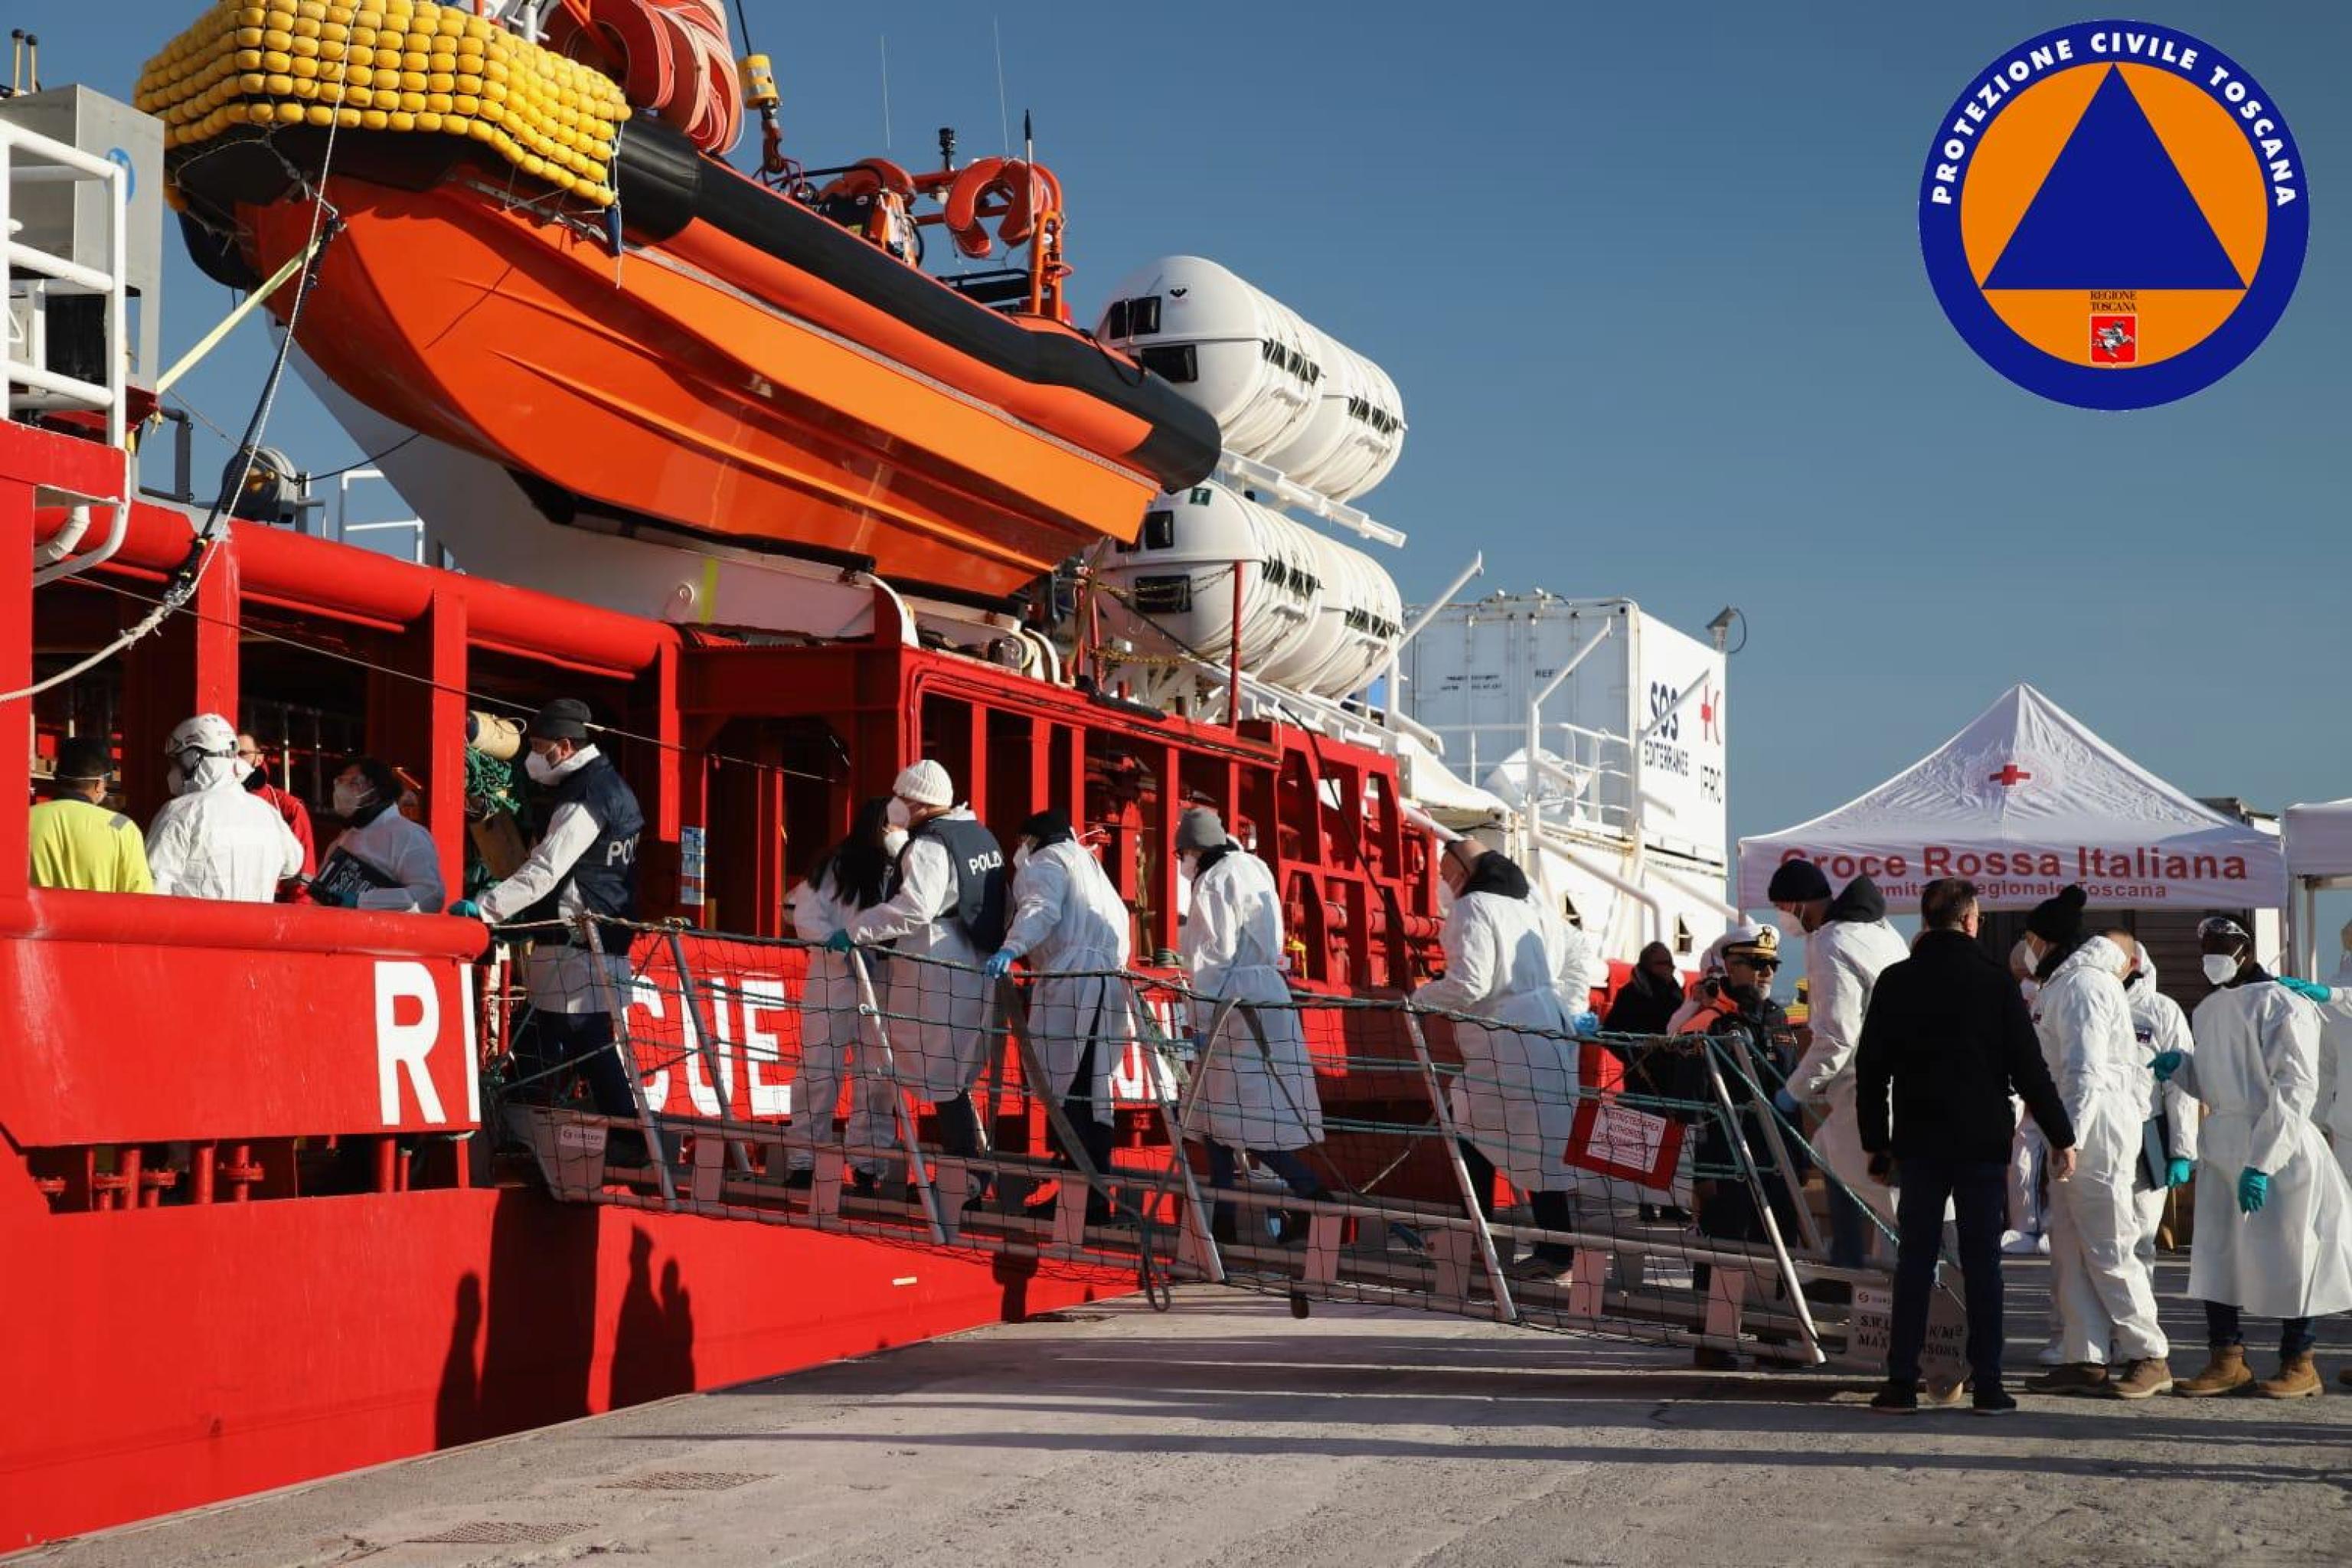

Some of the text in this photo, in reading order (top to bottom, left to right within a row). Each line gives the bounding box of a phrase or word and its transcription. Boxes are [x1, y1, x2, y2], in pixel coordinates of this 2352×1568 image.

[1651, 681, 1678, 741] SOS
[1923, 847, 2062, 877] Rossa
[2079, 846, 2247, 880] Italiana
[1976, 880, 2063, 900] egionale
[2076, 881, 2167, 898] Toscana
